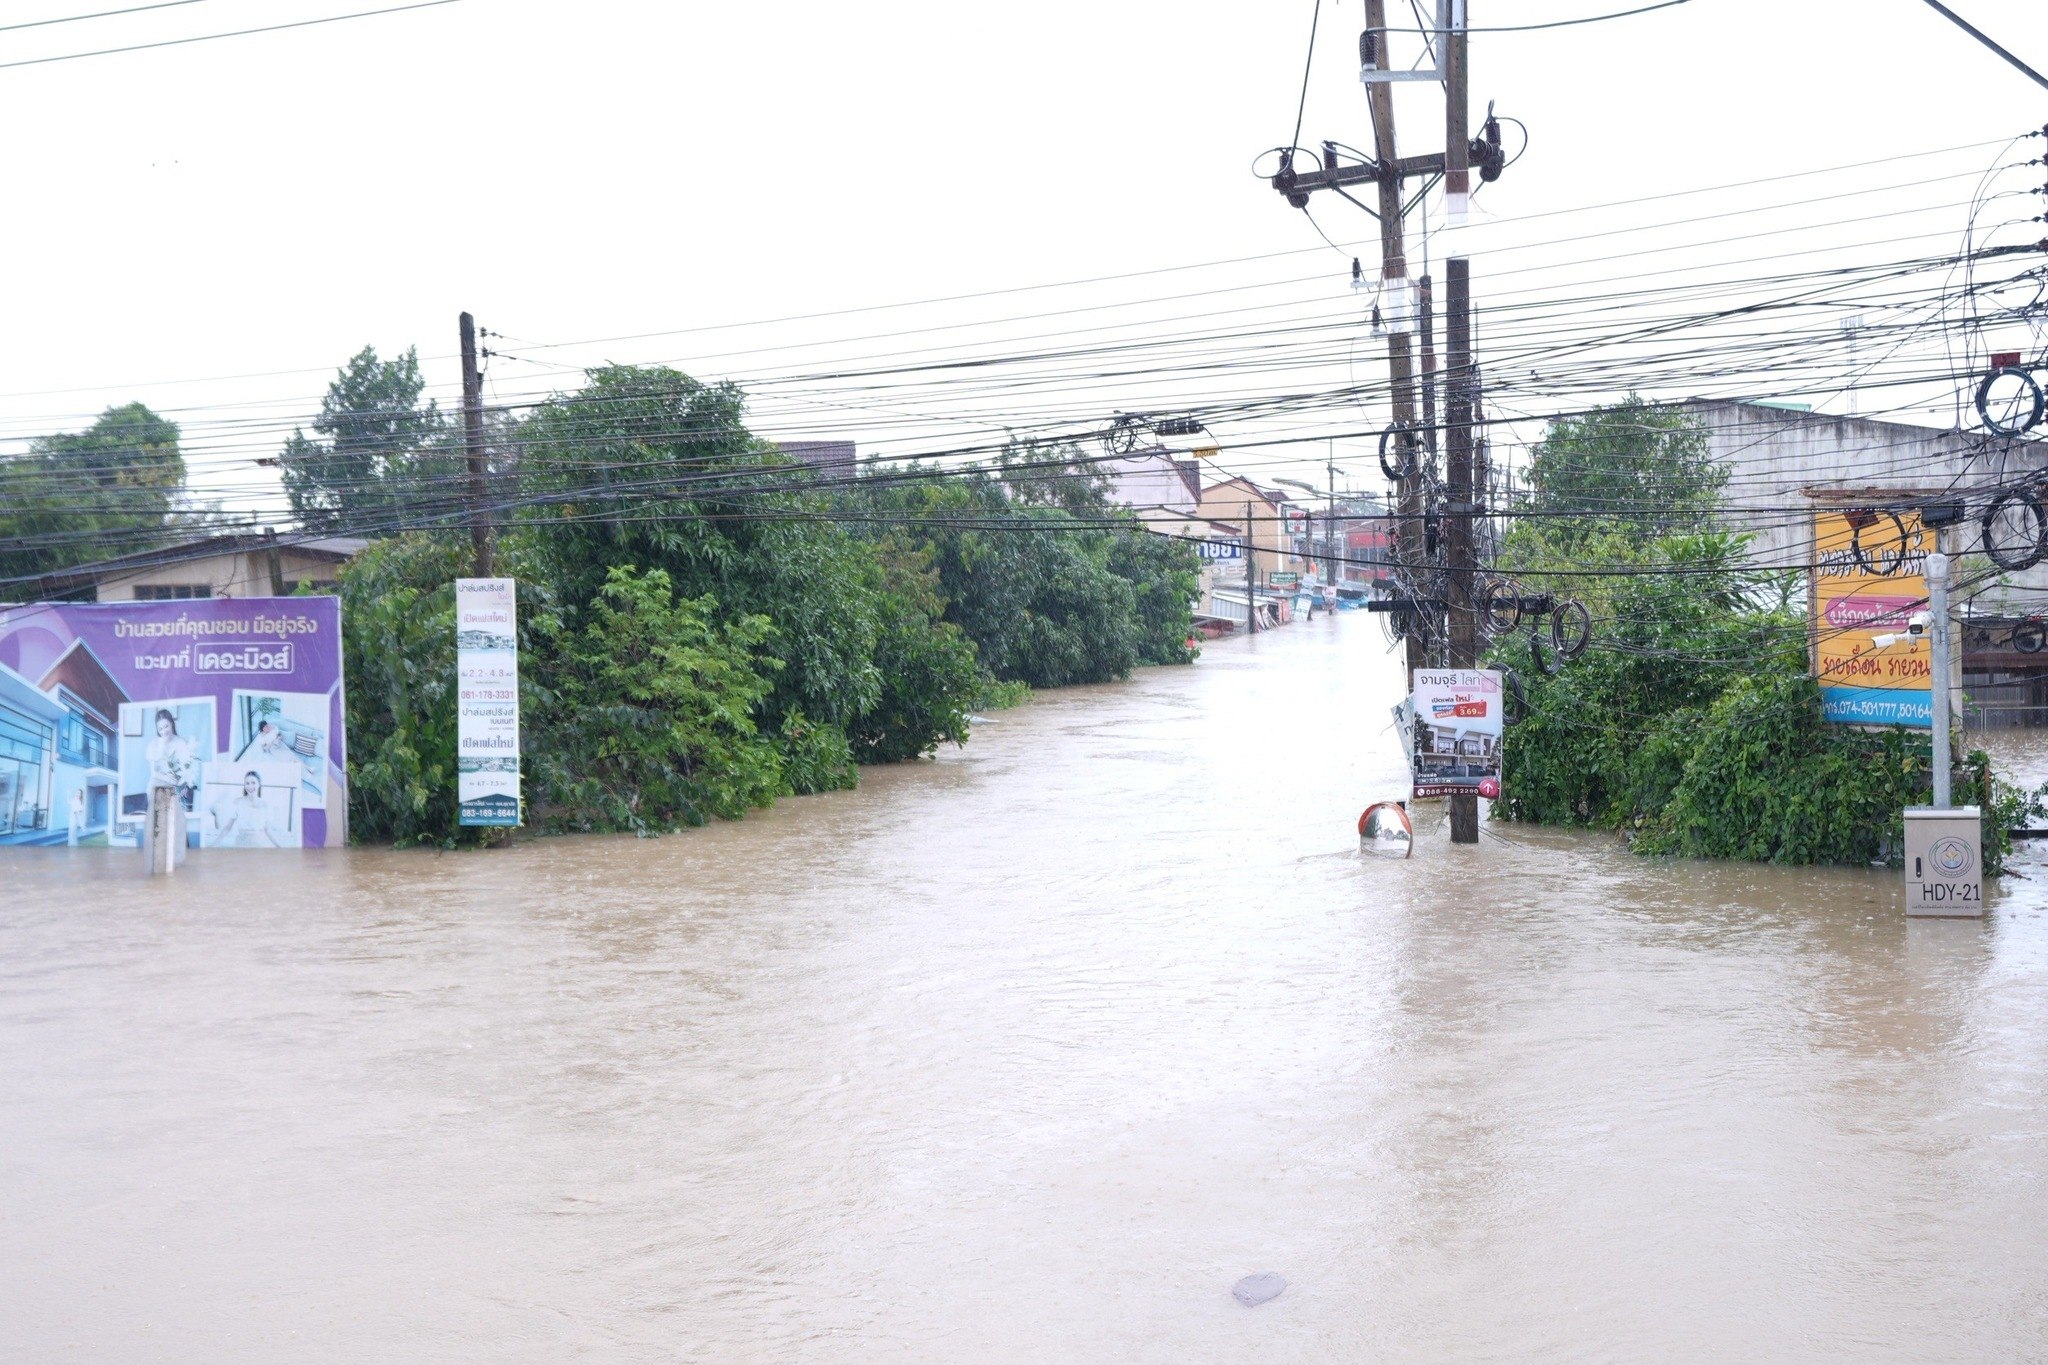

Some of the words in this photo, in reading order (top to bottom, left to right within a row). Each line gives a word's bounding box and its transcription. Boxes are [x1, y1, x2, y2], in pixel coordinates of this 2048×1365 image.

[1194, 539, 1241, 558] ายยา
[115, 612, 250, 641] บ้านสวยที่คุณชอบ
[253, 615, 318, 640] มีอยู่จริง
[135, 646, 190, 671] แวะมาที่
[198, 645, 291, 671] เดอะมิวส์
[1823, 644, 1882, 677] รายเดือน
[1888, 647, 1932, 677] รายวัน
[1420, 674, 1457, 688] จามจุรี
[1922, 883, 1981, 902] HDY-21
